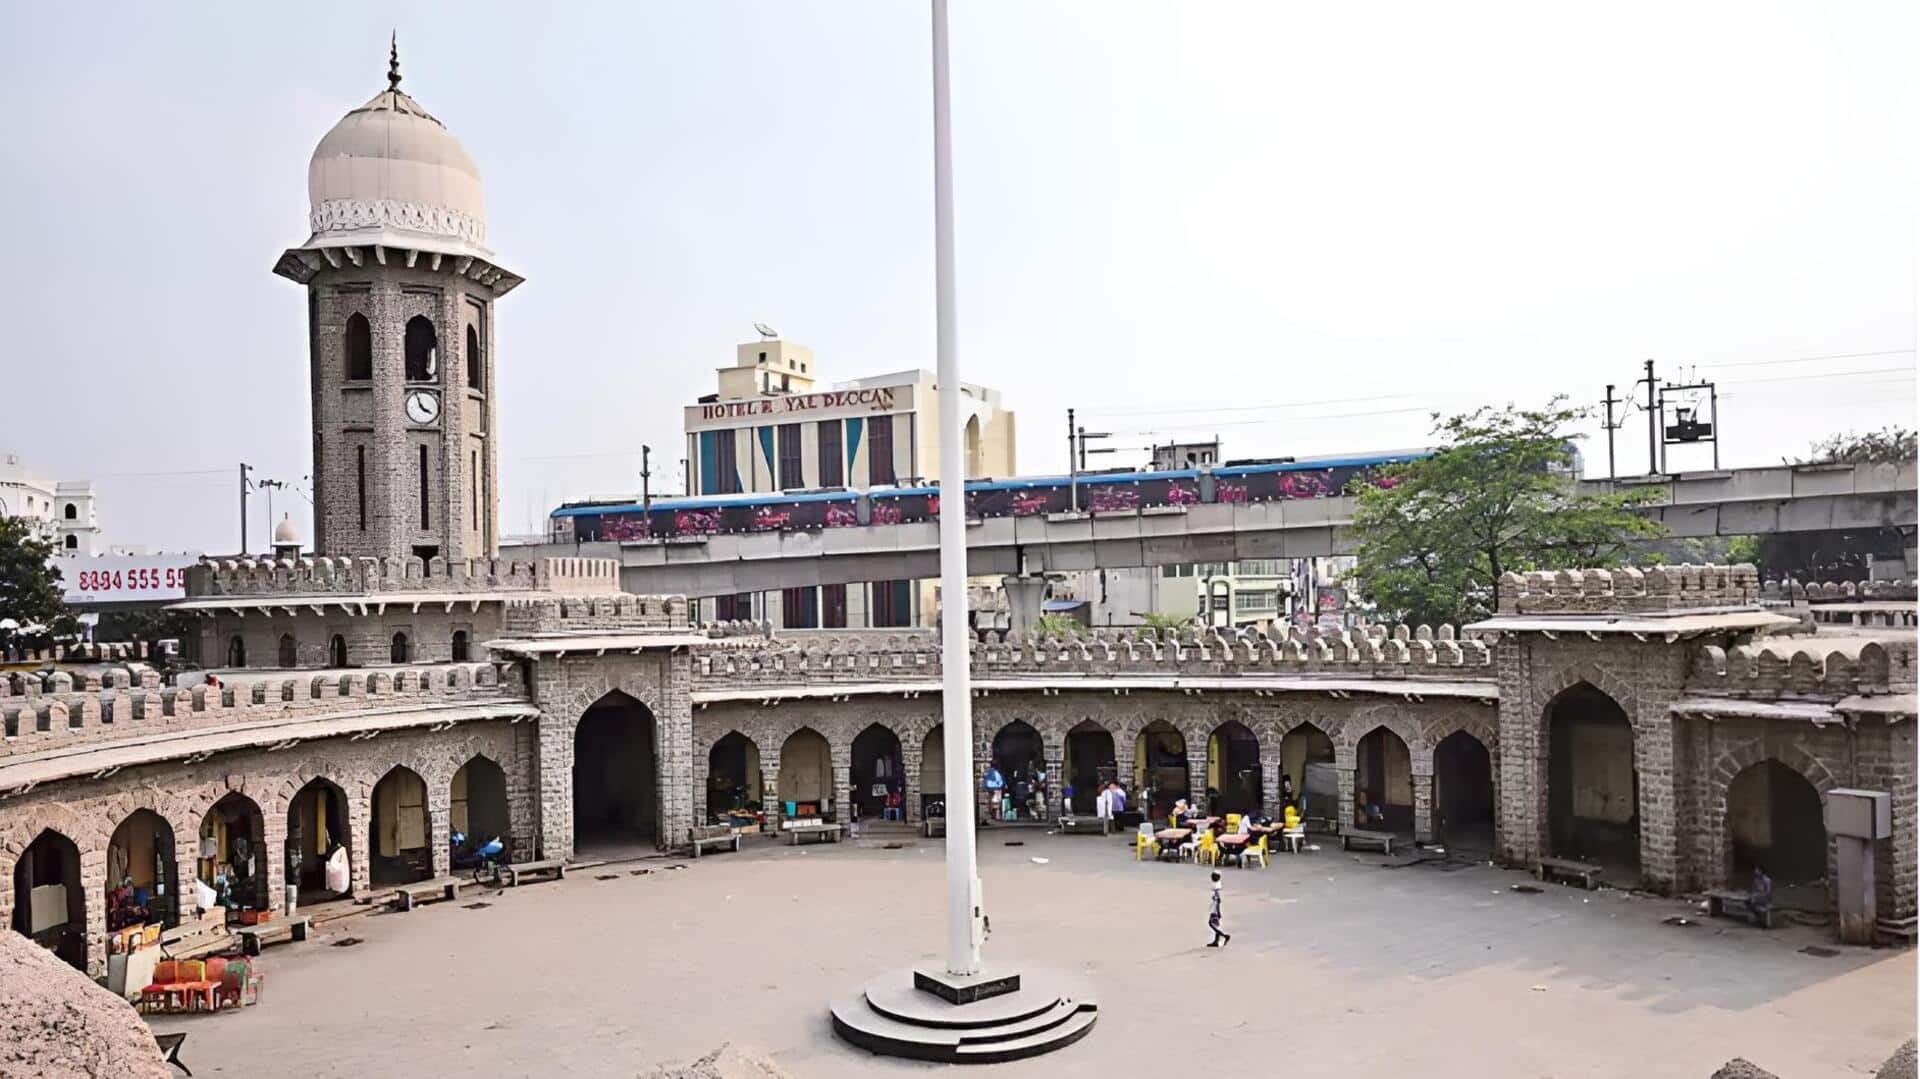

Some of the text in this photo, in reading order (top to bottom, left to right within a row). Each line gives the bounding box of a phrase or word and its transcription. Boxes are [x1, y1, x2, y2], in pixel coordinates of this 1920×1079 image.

[704, 402, 757, 418] HOTEL
[761, 396, 817, 412] RYAL
[823, 387, 894, 407] DECCAN
[128, 568, 160, 590] 555
